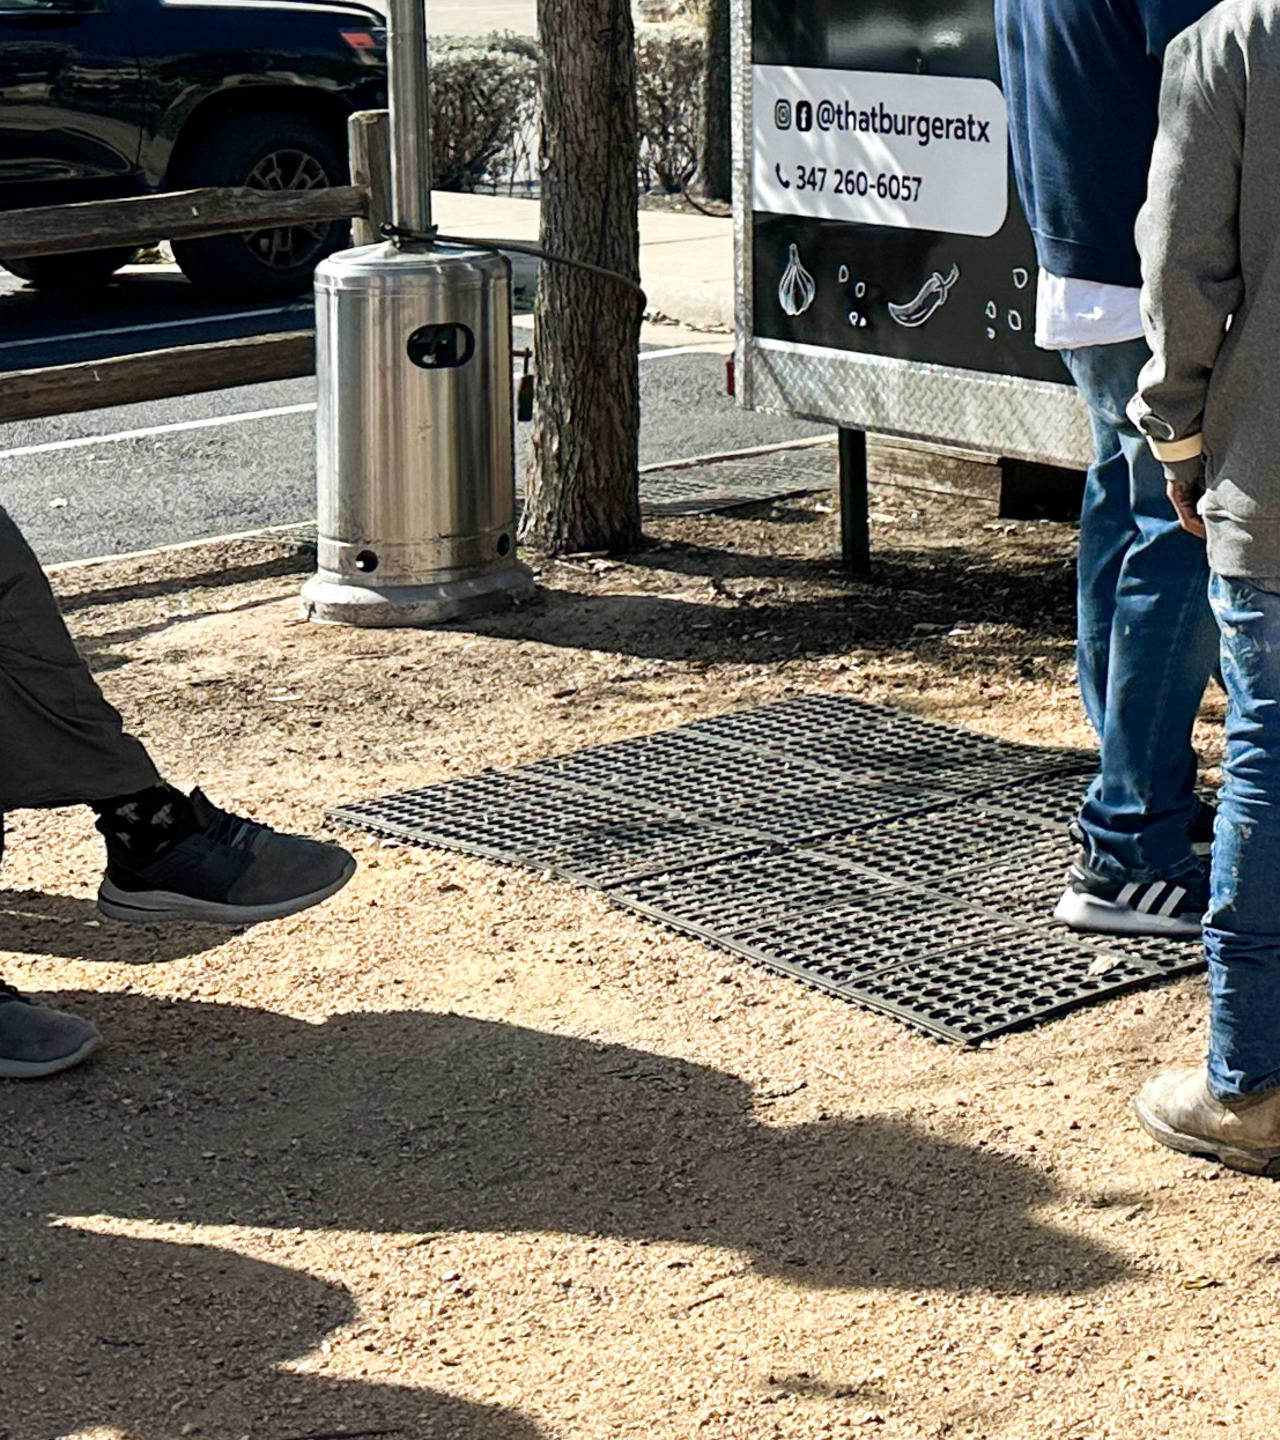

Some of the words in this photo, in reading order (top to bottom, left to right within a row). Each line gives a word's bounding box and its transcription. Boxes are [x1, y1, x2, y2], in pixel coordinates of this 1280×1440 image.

[816, 99, 990, 146] @thatburgeratx
[796, 165, 828, 192] 347
[834, 167, 923, 202] 260-6057
